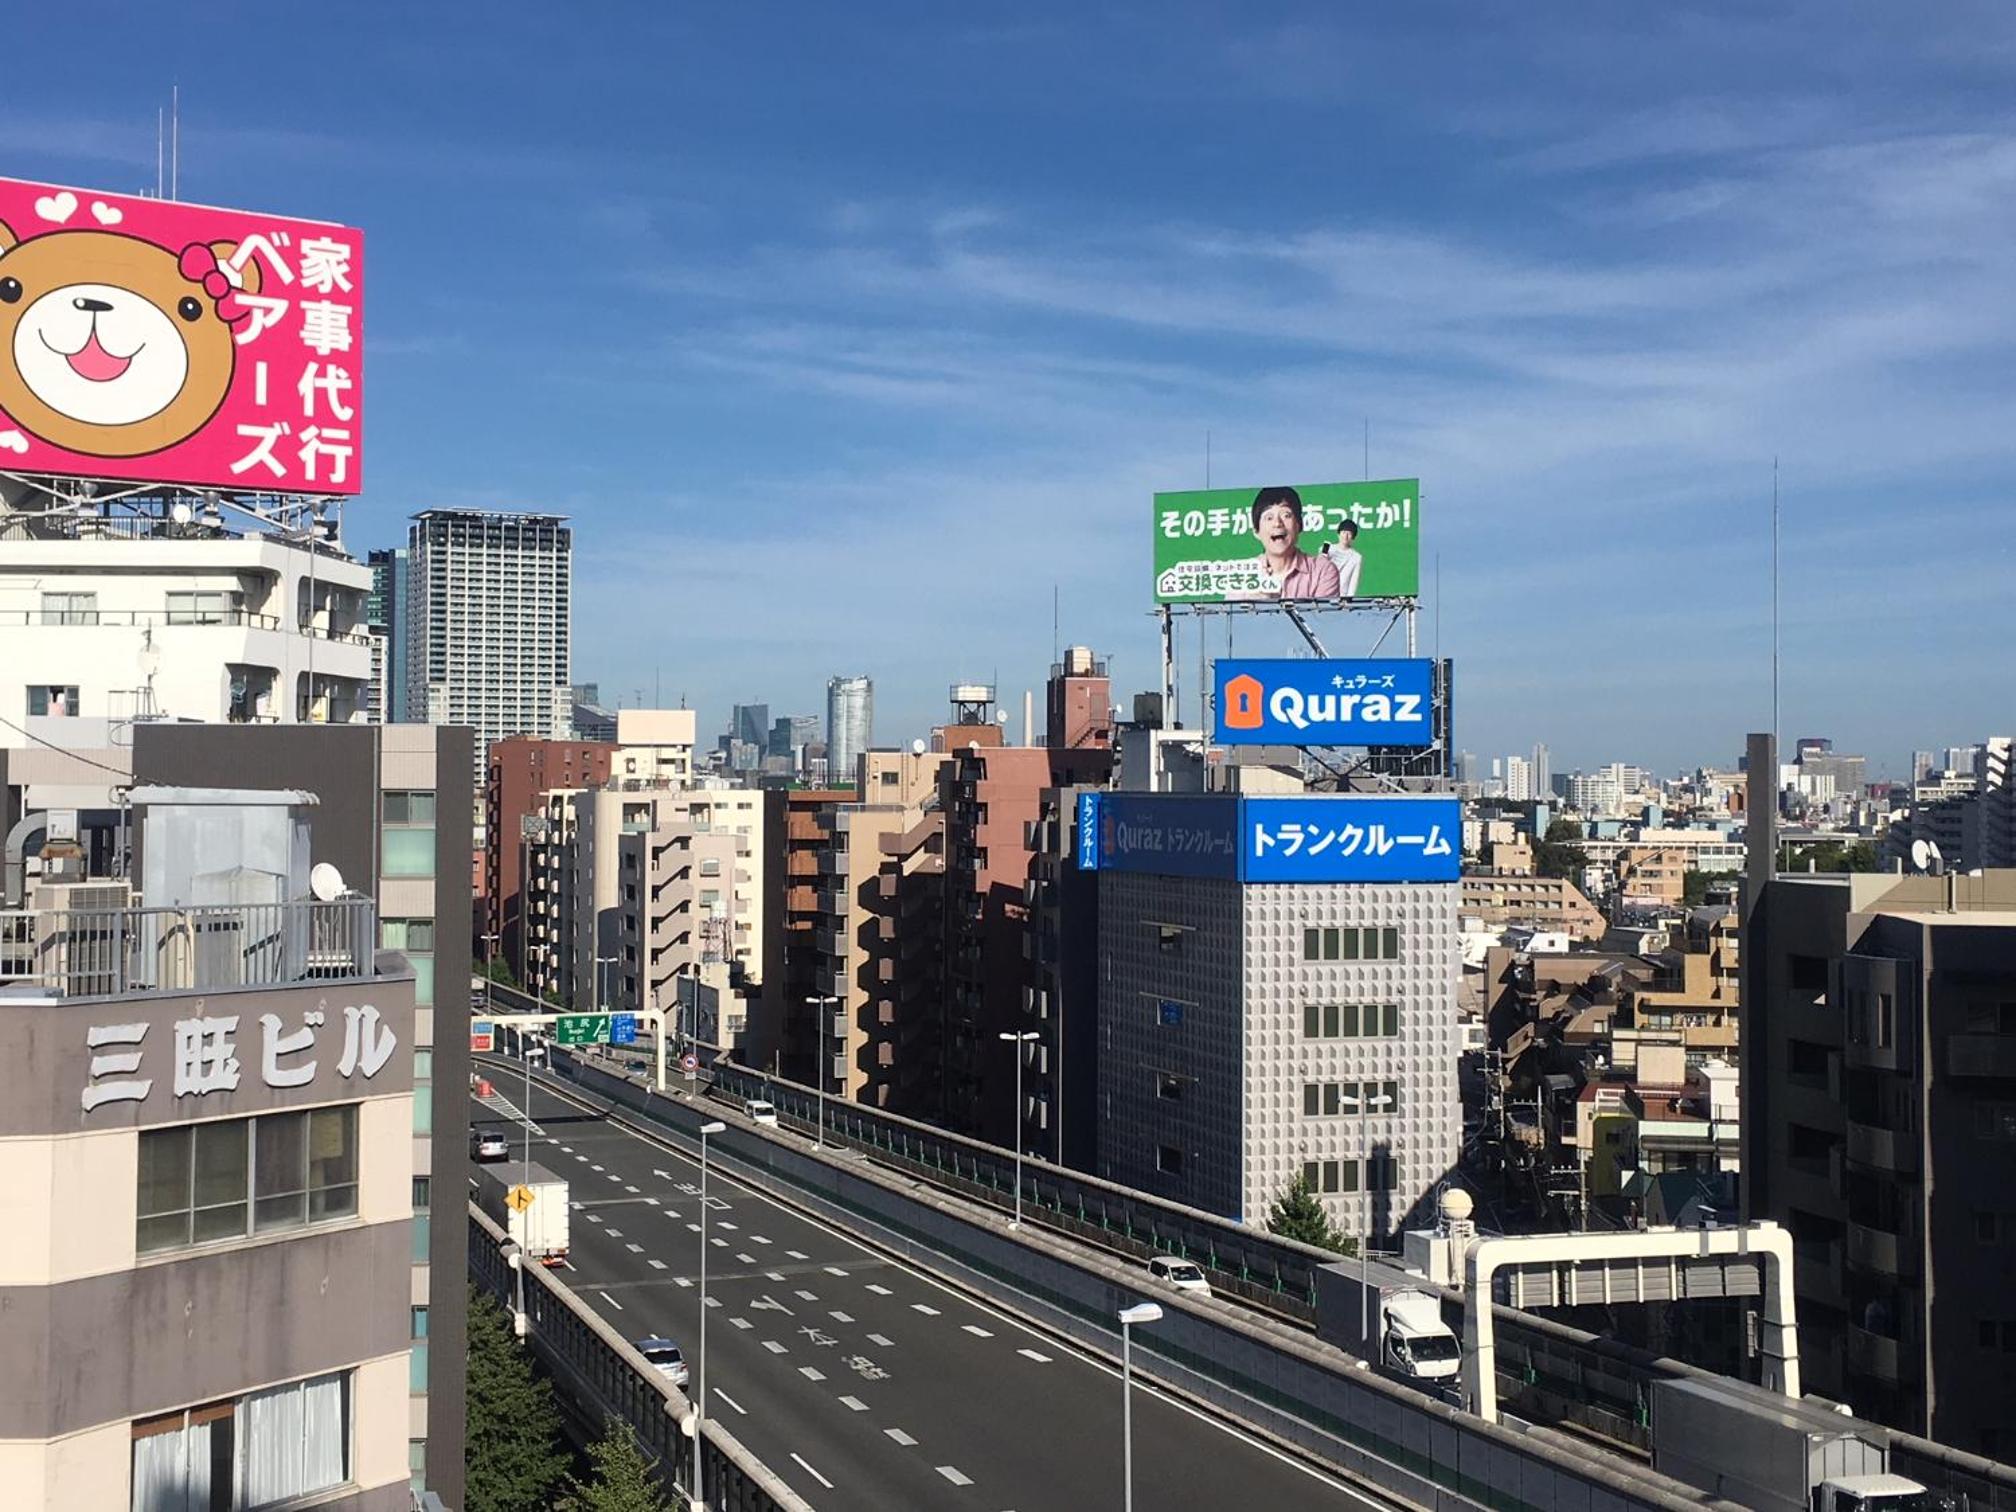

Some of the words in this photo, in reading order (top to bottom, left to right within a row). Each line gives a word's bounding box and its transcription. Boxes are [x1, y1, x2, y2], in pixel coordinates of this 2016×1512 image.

[227, 231, 295, 478] ベアーズ
[297, 236, 354, 484] 家事代行
[1178, 573, 1278, 592] 交換できるくん
[1331, 674, 1396, 689] キュラーズ
[1269, 686, 1423, 730] Quraz
[1083, 795, 1094, 867] トランクルーム
[1117, 821, 1163, 853] Quraz
[1167, 827, 1235, 855] トランクルーム
[1255, 822, 1452, 858] トランクルーム
[81, 1004, 398, 1113] 三旺ビル
